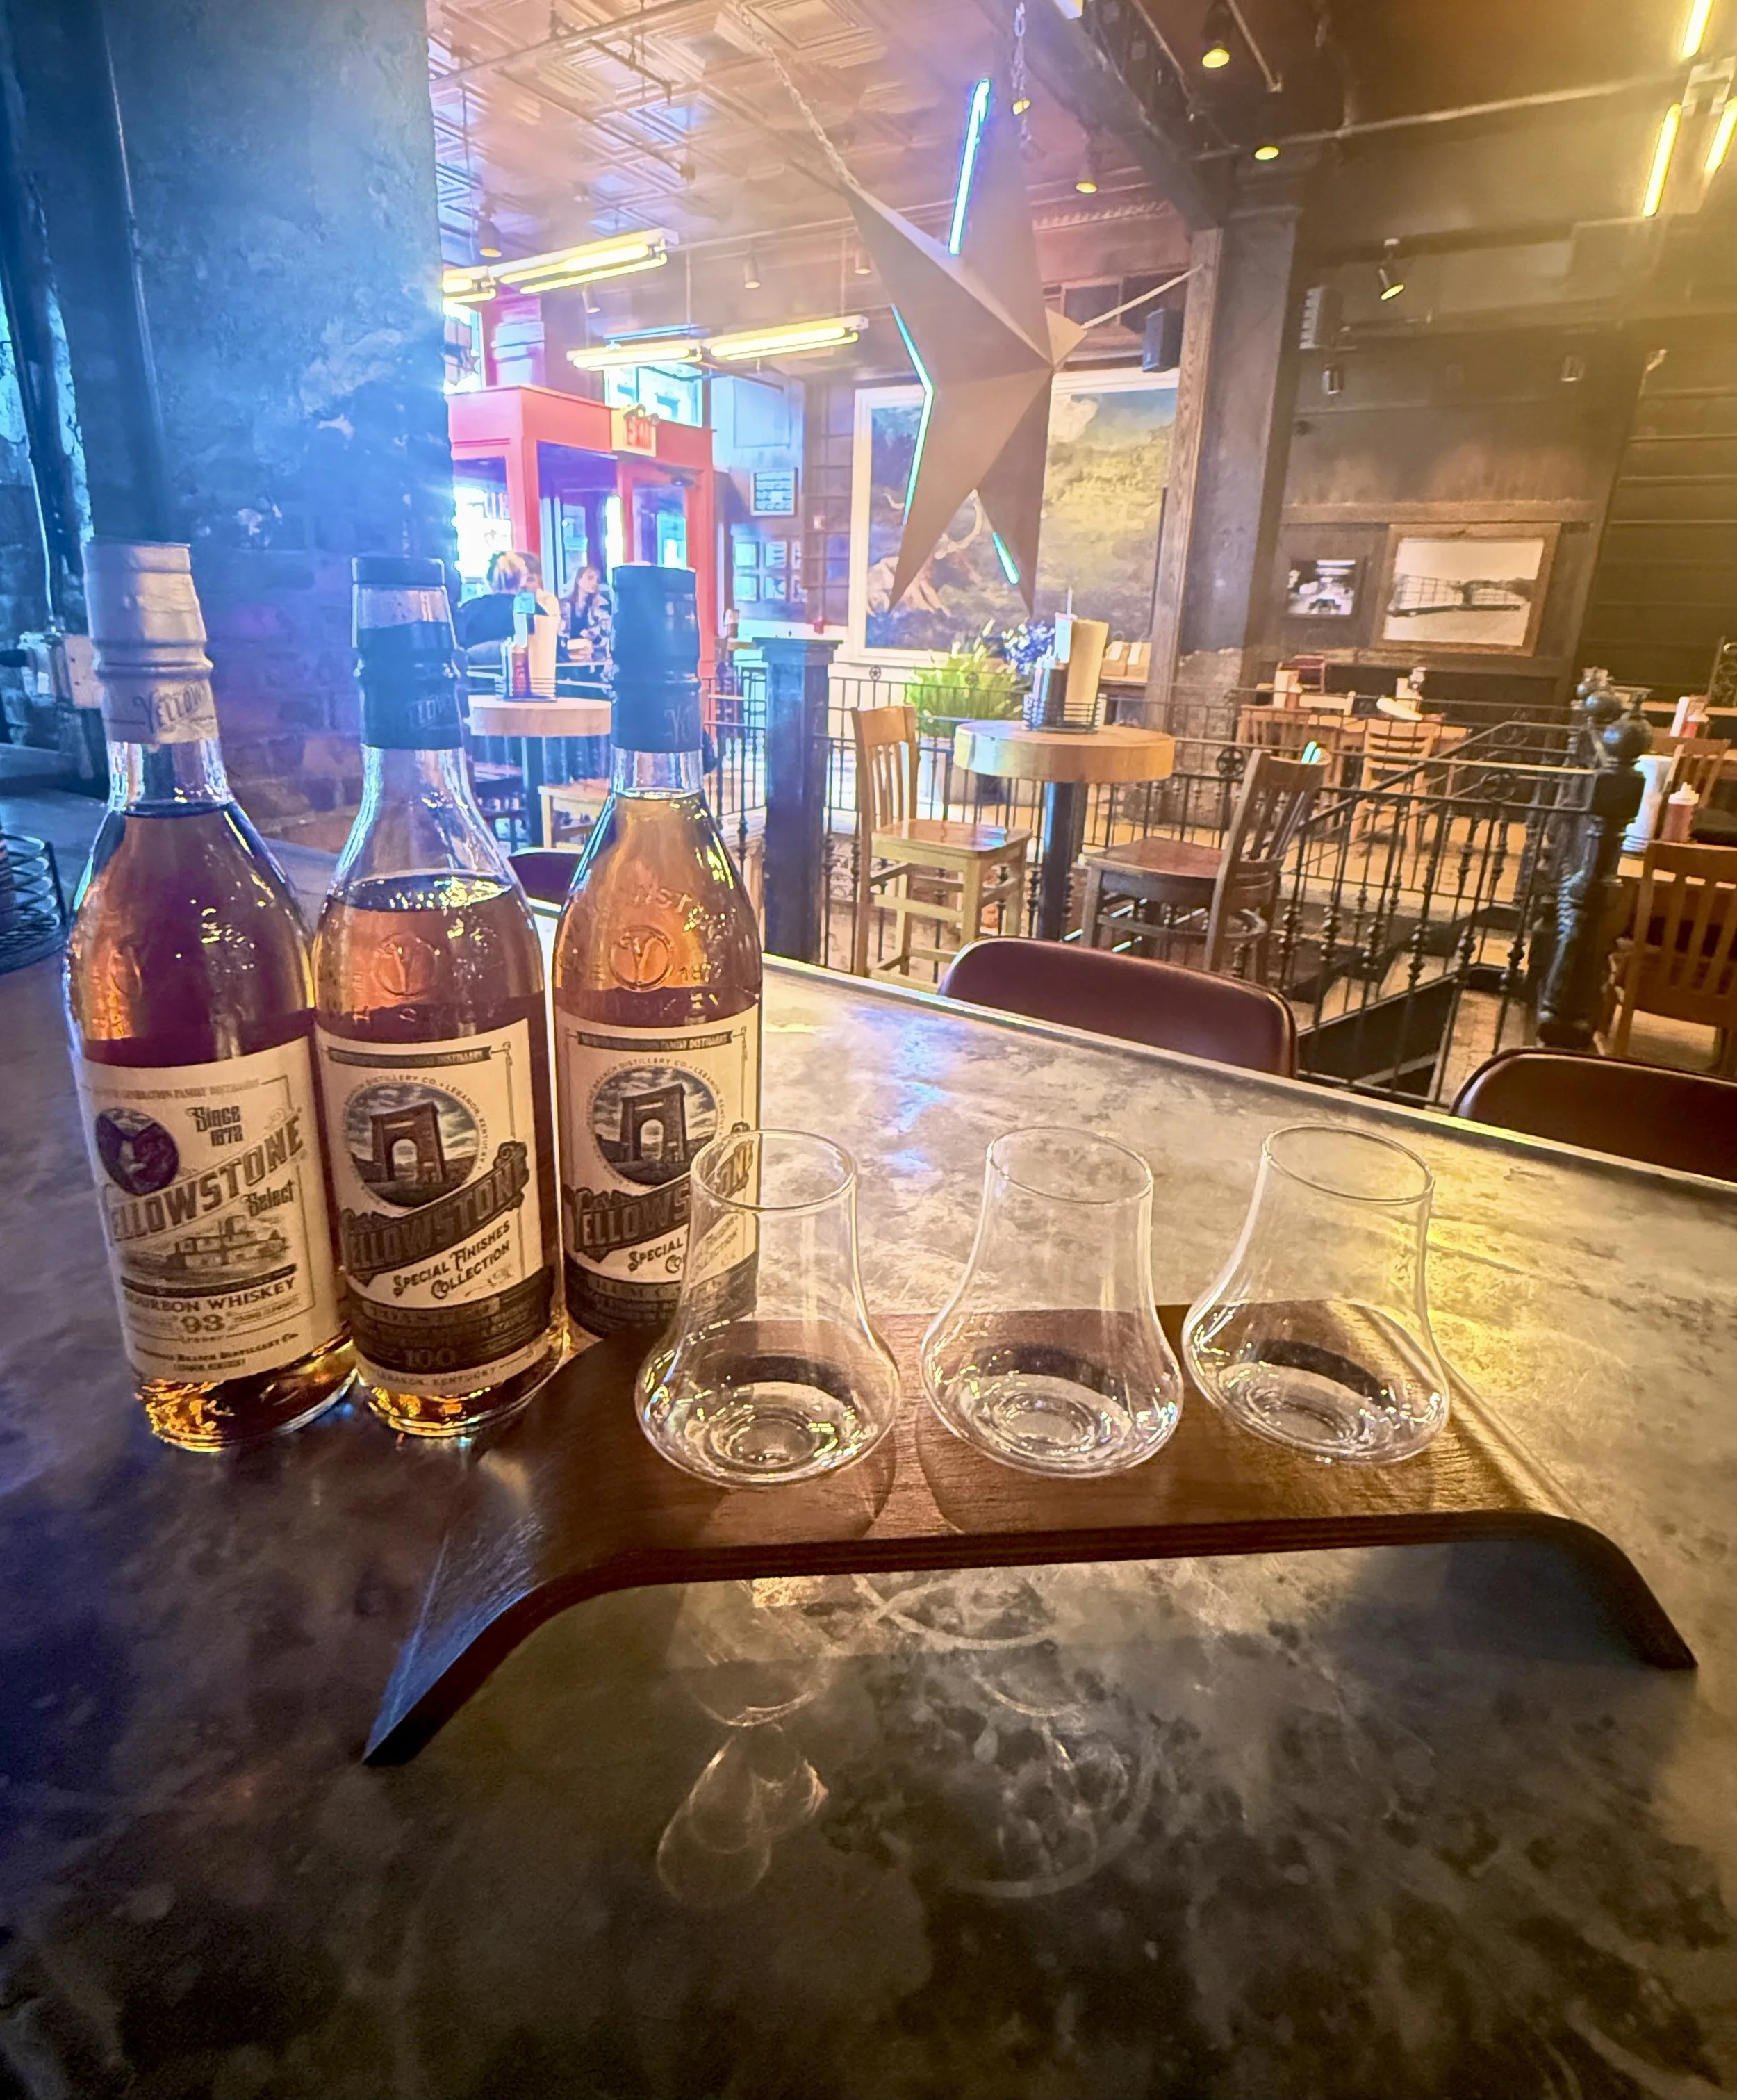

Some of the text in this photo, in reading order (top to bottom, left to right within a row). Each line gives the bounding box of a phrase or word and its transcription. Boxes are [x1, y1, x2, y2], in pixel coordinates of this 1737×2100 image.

[392, 1263, 450, 1297] SPECIAL
[450, 1220, 511, 1271] FINISHES
[431, 1240, 511, 1300] COLLECTION
[627, 1238, 683, 1272] SPECIAL
[208, 1277, 295, 1311] WHISKEY
